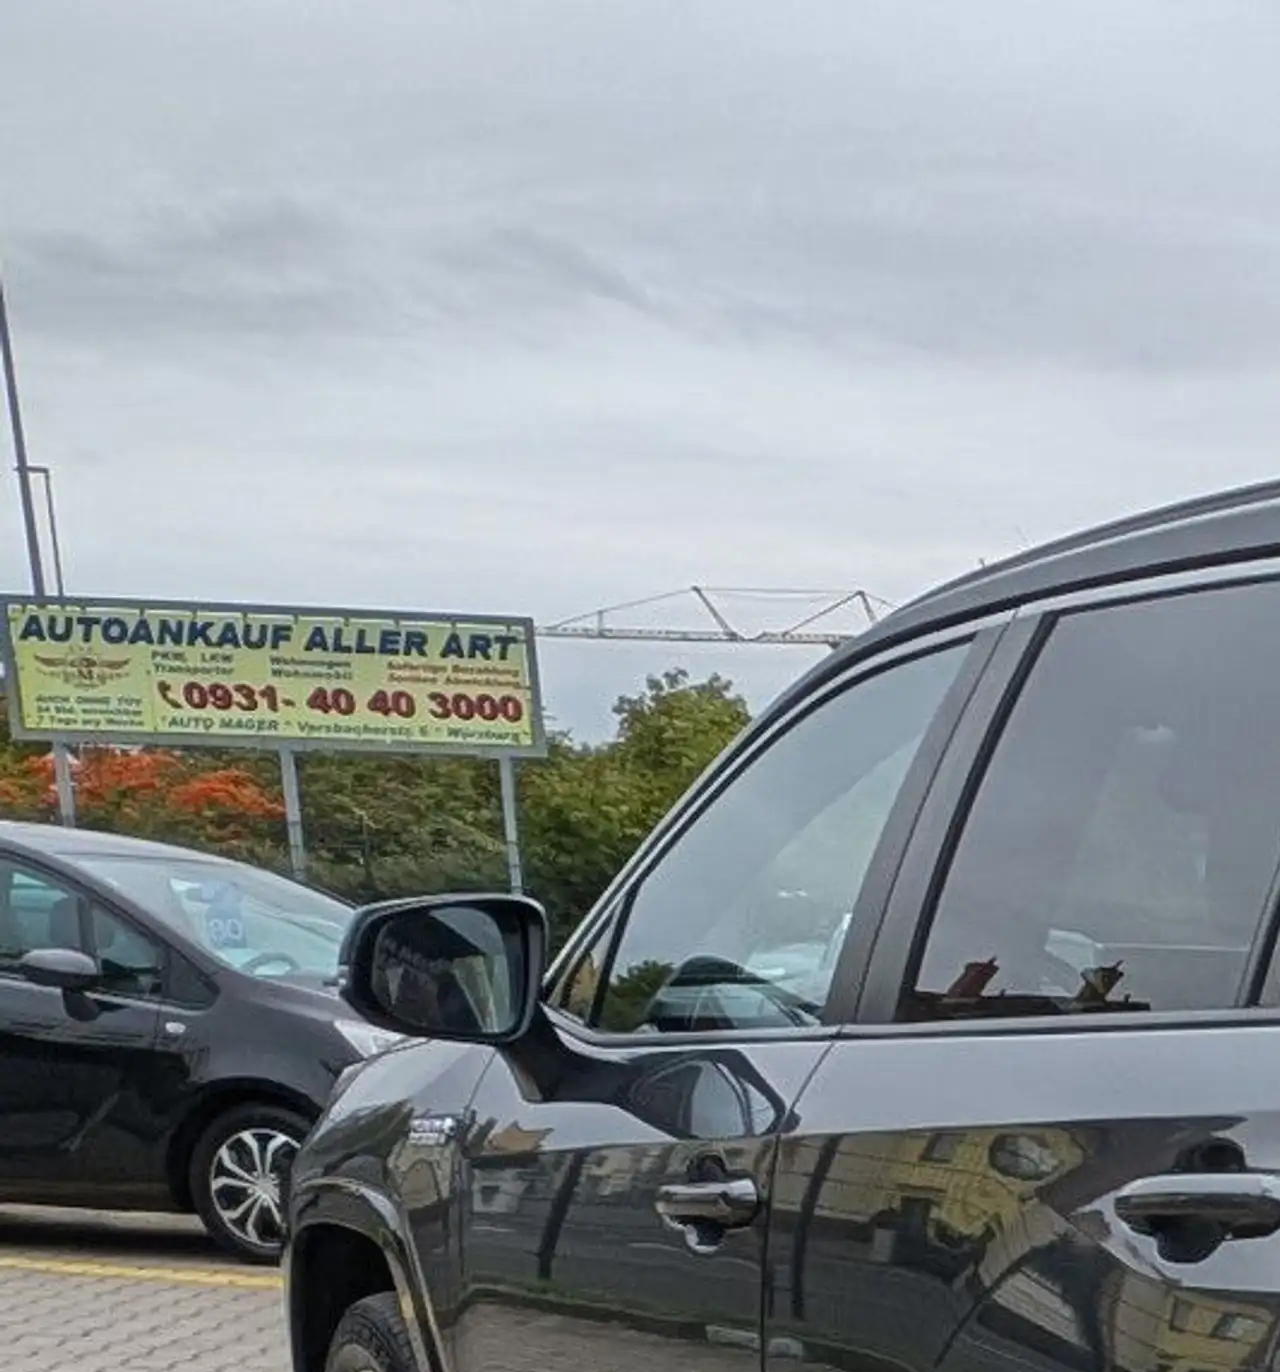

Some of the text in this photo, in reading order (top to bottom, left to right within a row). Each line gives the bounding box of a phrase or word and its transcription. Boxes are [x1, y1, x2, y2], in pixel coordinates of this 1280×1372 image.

[20, 614, 517, 661] AUTOANKAUF ALLER ART
[307, 687, 356, 717] 40
[367, 689, 416, 718] 40
[428, 691, 523, 723] 3000
